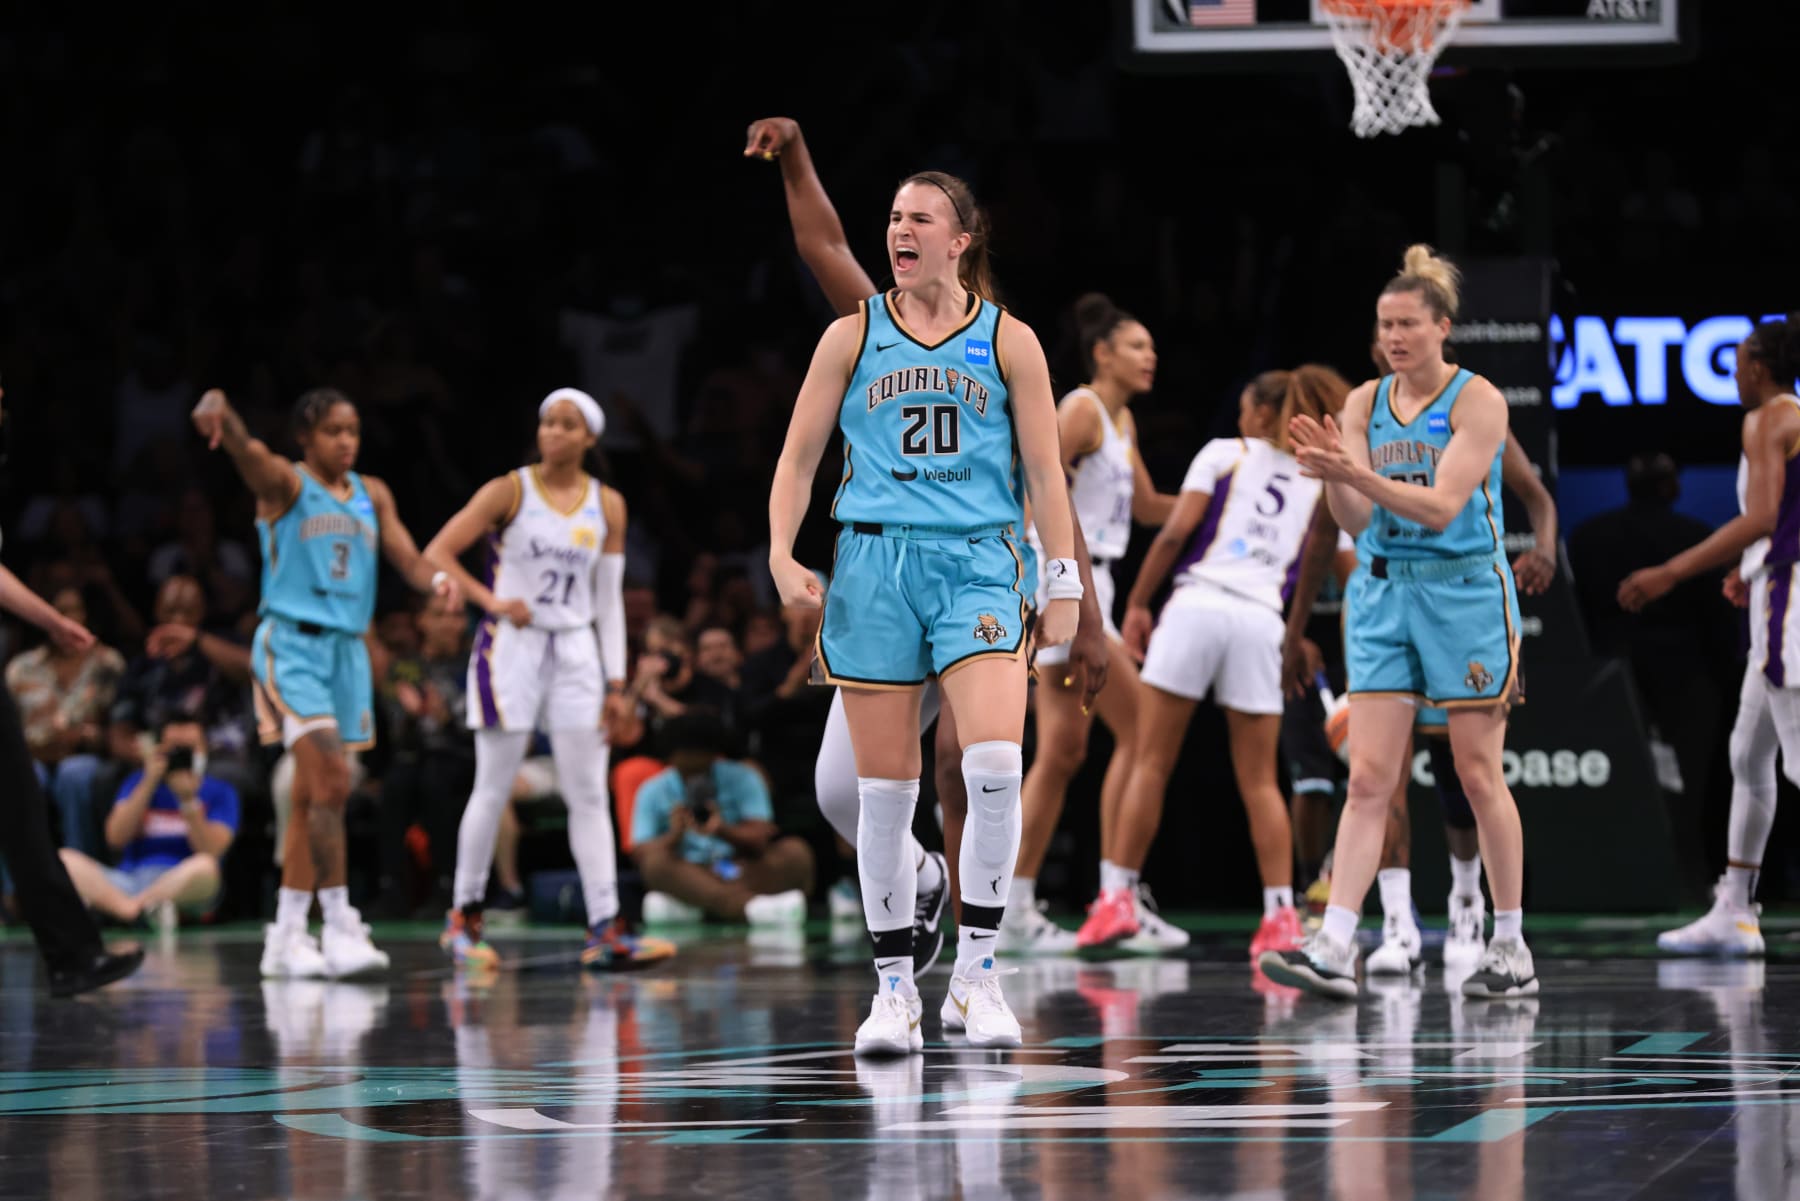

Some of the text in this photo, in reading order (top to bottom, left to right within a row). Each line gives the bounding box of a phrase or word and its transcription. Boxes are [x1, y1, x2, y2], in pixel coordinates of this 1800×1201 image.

[967, 346, 987, 357] HSS
[901, 405, 960, 456] 20
[923, 468, 971, 482] Webull
[1255, 473, 1291, 518] 5
[330, 541, 351, 580] 3
[534, 568, 576, 606] 21
